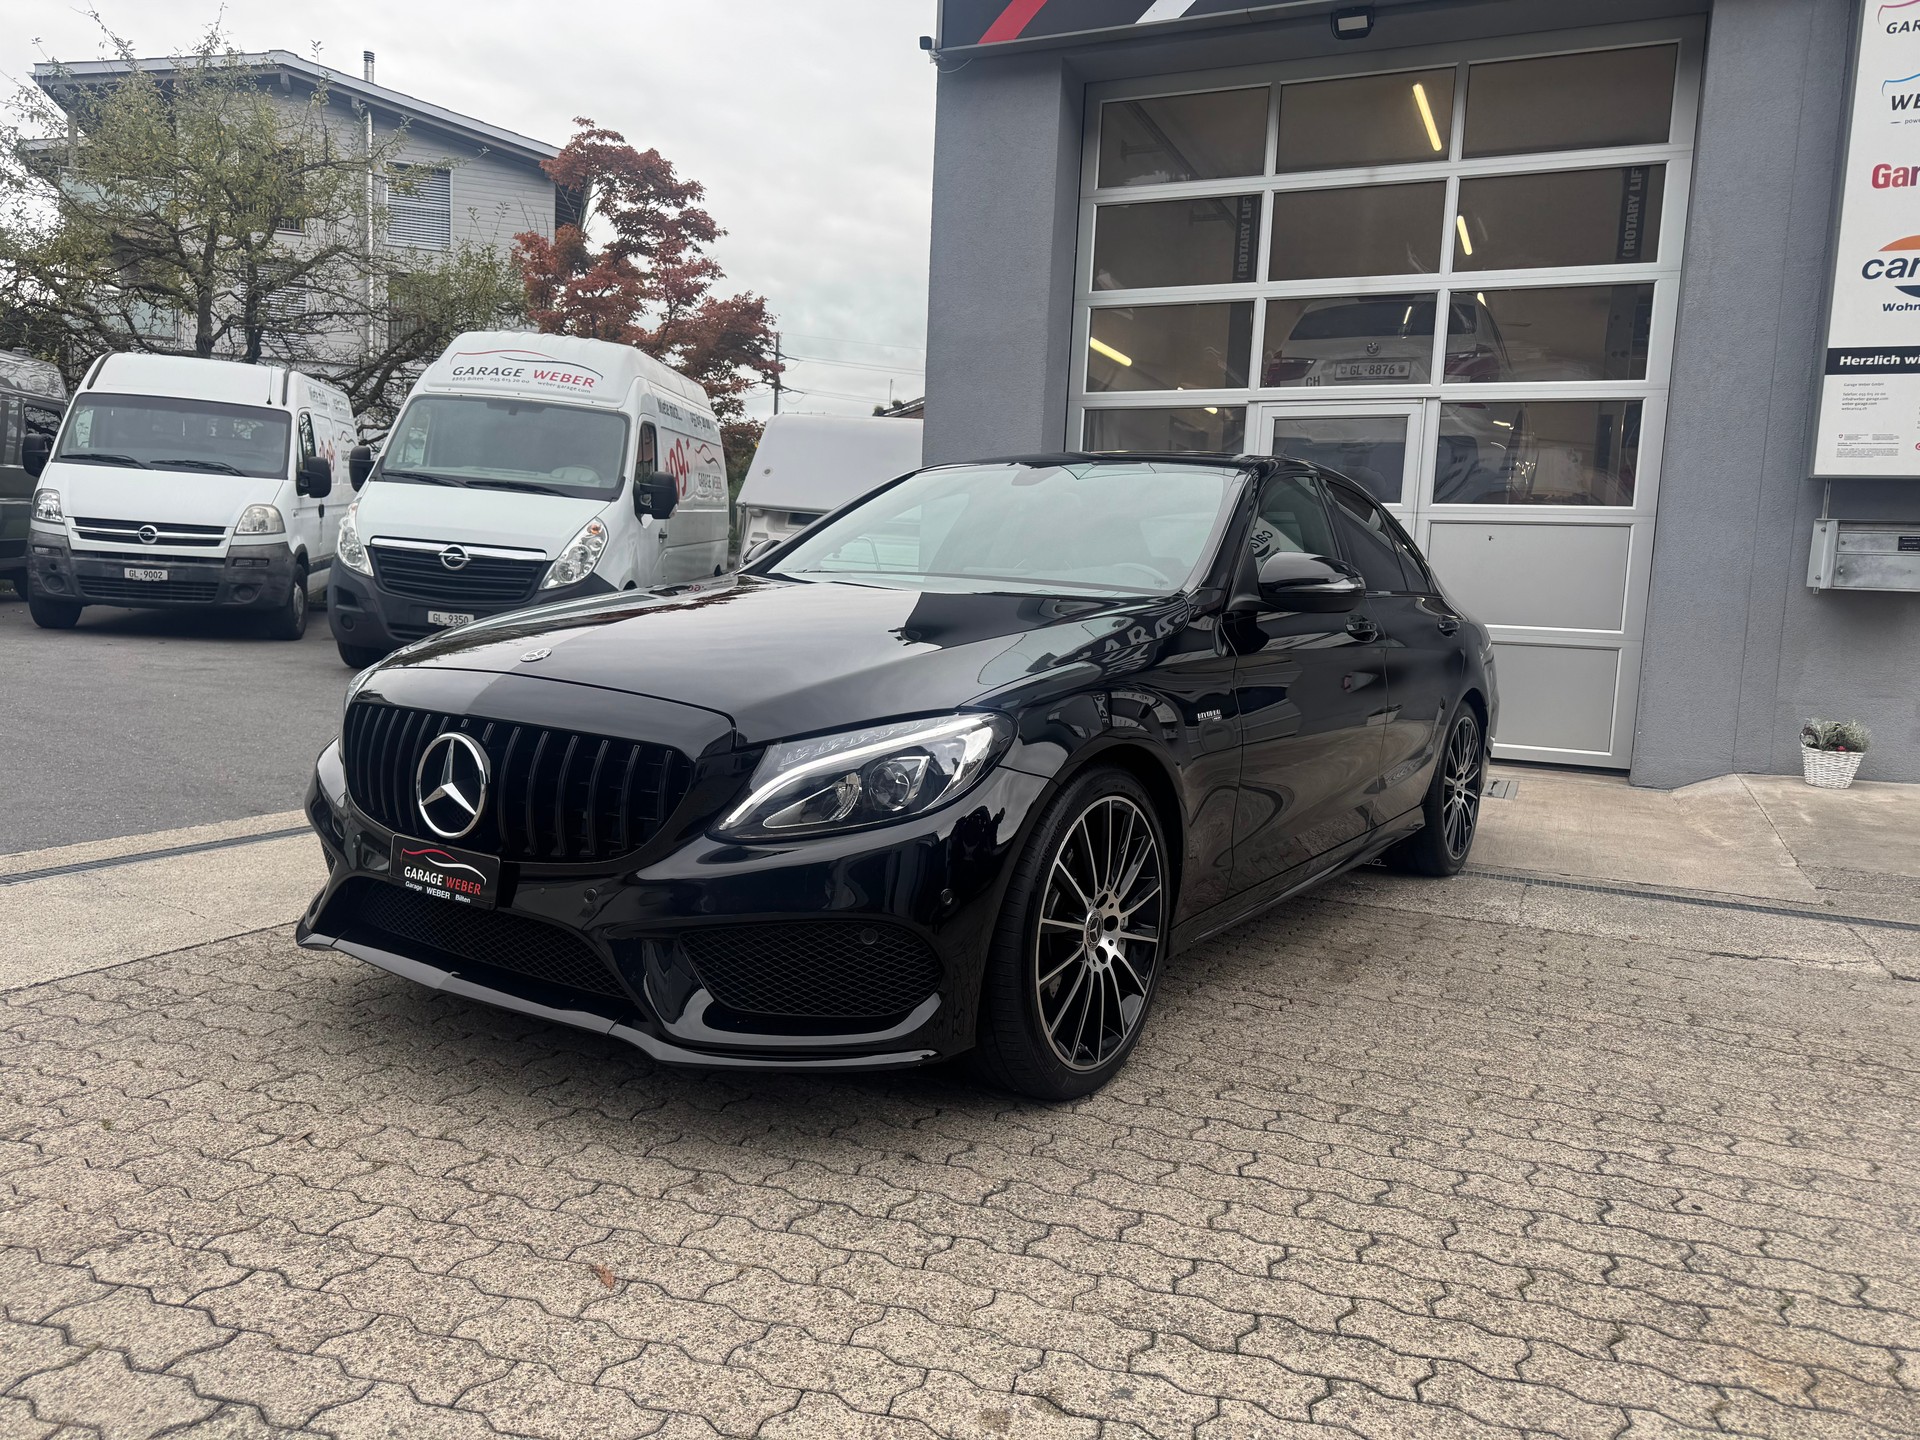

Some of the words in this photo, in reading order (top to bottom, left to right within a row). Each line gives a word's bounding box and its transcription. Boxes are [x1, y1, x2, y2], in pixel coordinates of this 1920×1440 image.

[1886, 19, 1920, 34] GAR
[1872, 163, 1920, 189] Gar
[1241, 195, 1253, 219] LIF
[1623, 195, 1640, 250] ROTARY
[1238, 222, 1251, 272] ROTARY
[1861, 257, 1920, 280] car
[1882, 302, 1920, 312] Wohn
[1840, 355, 1900, 366] Herzlich
[452, 366, 526, 378] GARAGE
[533, 369, 595, 388] WEBER
[1306, 376, 1321, 387] CH
[404, 866, 444, 886] GARAGE
[446, 876, 481, 895] WEBER
[405, 880, 423, 892] Garage
[426, 886, 450, 900] WEBER
[455, 894, 471, 904] Bilten
